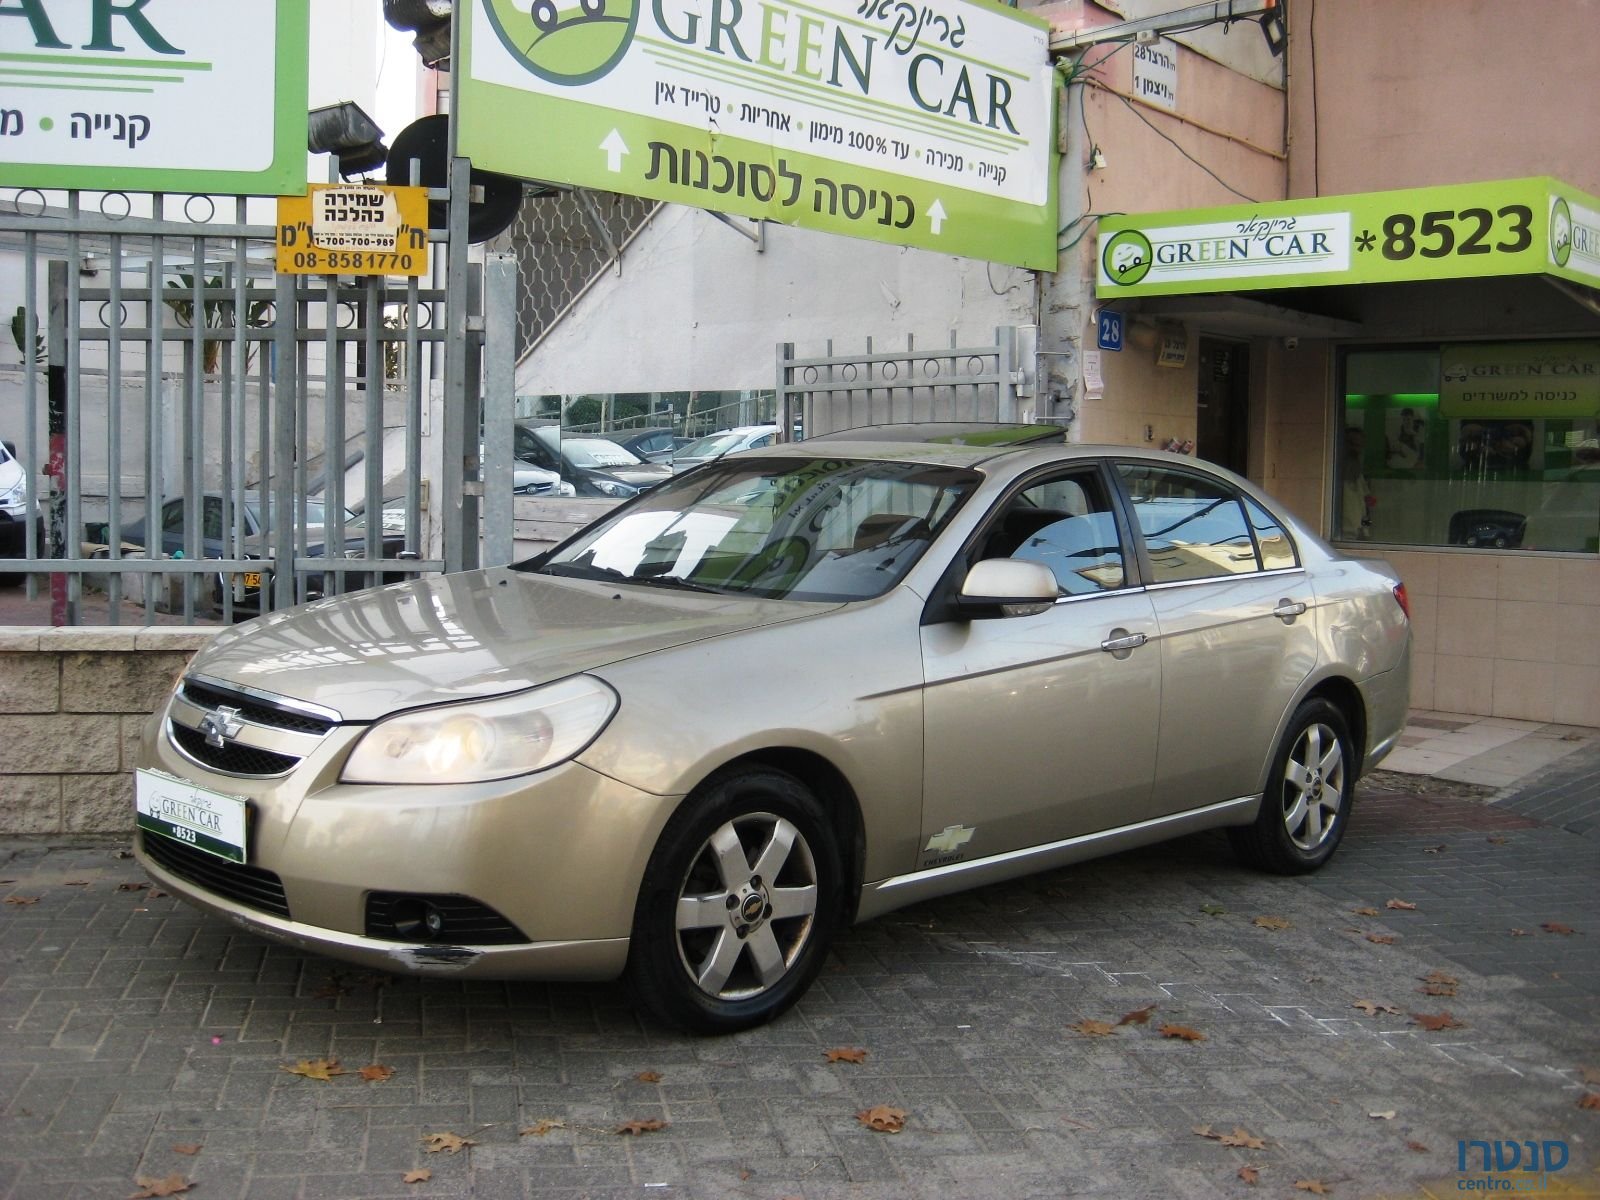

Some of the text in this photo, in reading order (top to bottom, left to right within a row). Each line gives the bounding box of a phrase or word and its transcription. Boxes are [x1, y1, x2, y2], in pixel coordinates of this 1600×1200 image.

[1135, 45, 1146, 60] 28
[1146, 46, 1169, 69] הרצל
[651, 0, 1020, 135] GREEN CAR
[1135, 76, 1139, 88] 1
[1143, 78, 1167, 98] ויצמן
[70, 112, 151, 149] קנייה
[655, 81, 1007, 186] קנייה מכירה עד 100% מימון אחריות טרייד אין
[644, 141, 915, 229] כניסה לסוכנות
[325, 193, 384, 207] שמירה
[325, 207, 384, 223] כהלכה
[1235, 214, 1297, 242] גרינקאר
[315, 237, 395, 247] 1-700-700-989
[1157, 232, 1332, 264] GREEN CAR
[294, 252, 412, 270] 08-8581770
[1102, 318, 1119, 343] 28
[1472, 364, 1594, 376] GREEN CAR
[1463, 390, 1577, 401] כניסה למשרדים
[162, 799, 221, 831] GREEN CAR
